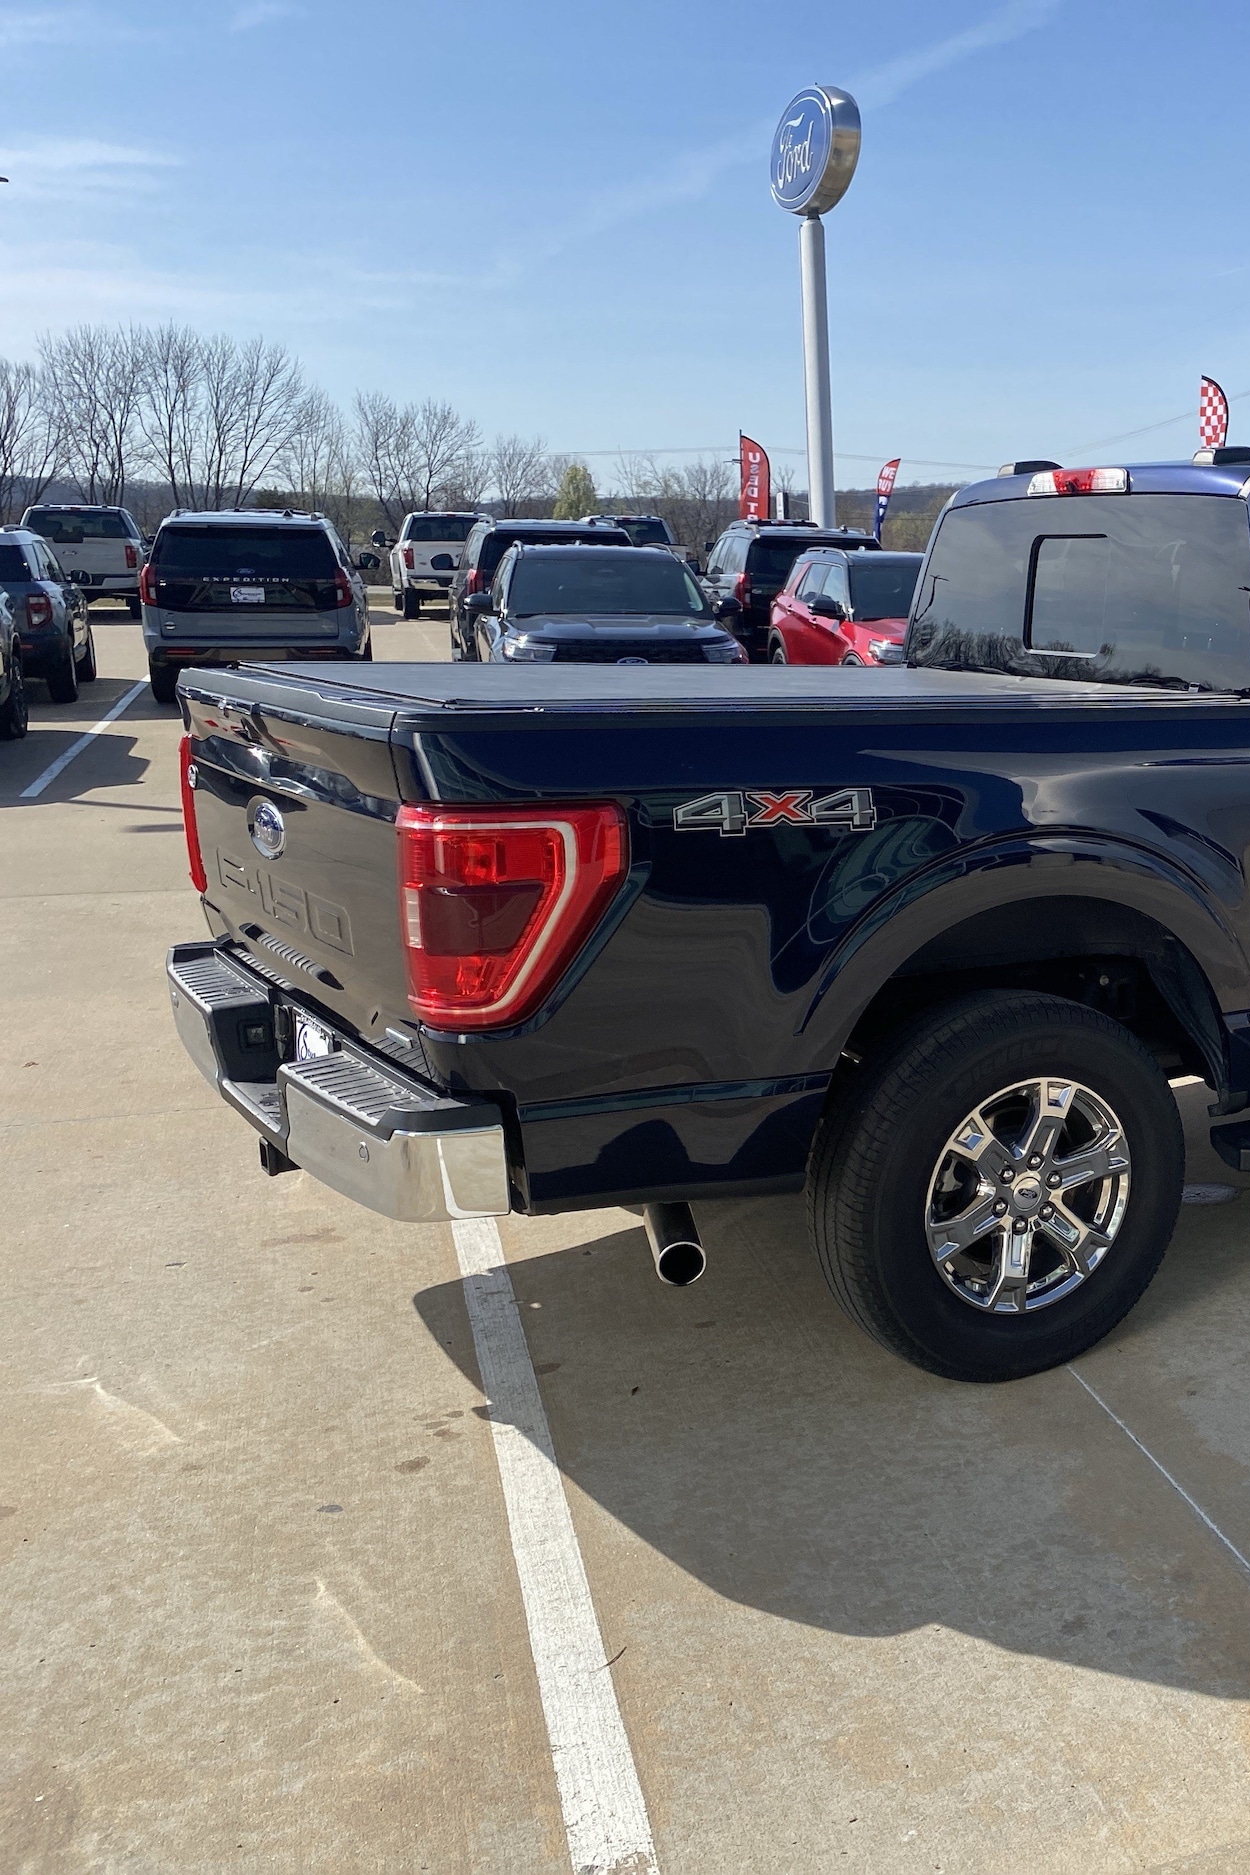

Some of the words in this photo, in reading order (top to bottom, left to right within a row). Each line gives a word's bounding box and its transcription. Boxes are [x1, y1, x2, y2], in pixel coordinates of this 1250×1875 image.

[777, 112, 814, 190] Ford
[881, 466, 896, 479] WE
[216, 847, 355, 957] F-150
